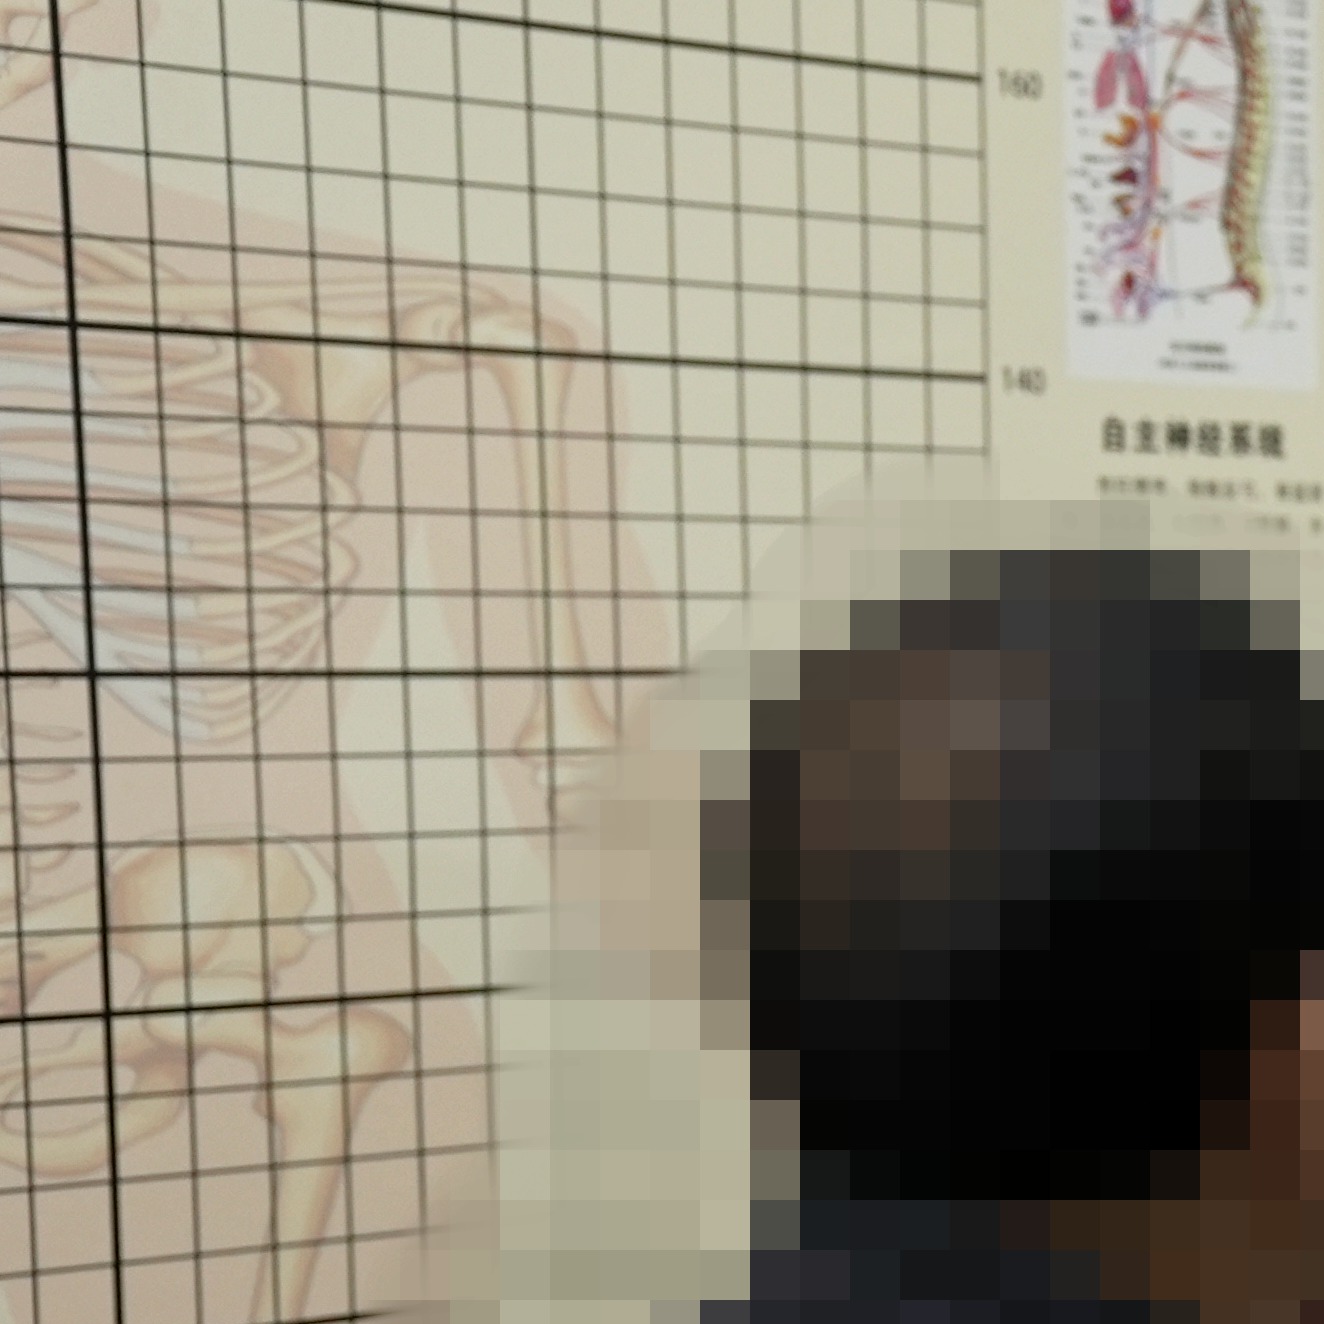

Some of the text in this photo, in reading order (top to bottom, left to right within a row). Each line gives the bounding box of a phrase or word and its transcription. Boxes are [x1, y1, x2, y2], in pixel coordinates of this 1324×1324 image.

[1002, 366, 1047, 396] 140
[1101, 416, 1286, 460] 自主神经系统
